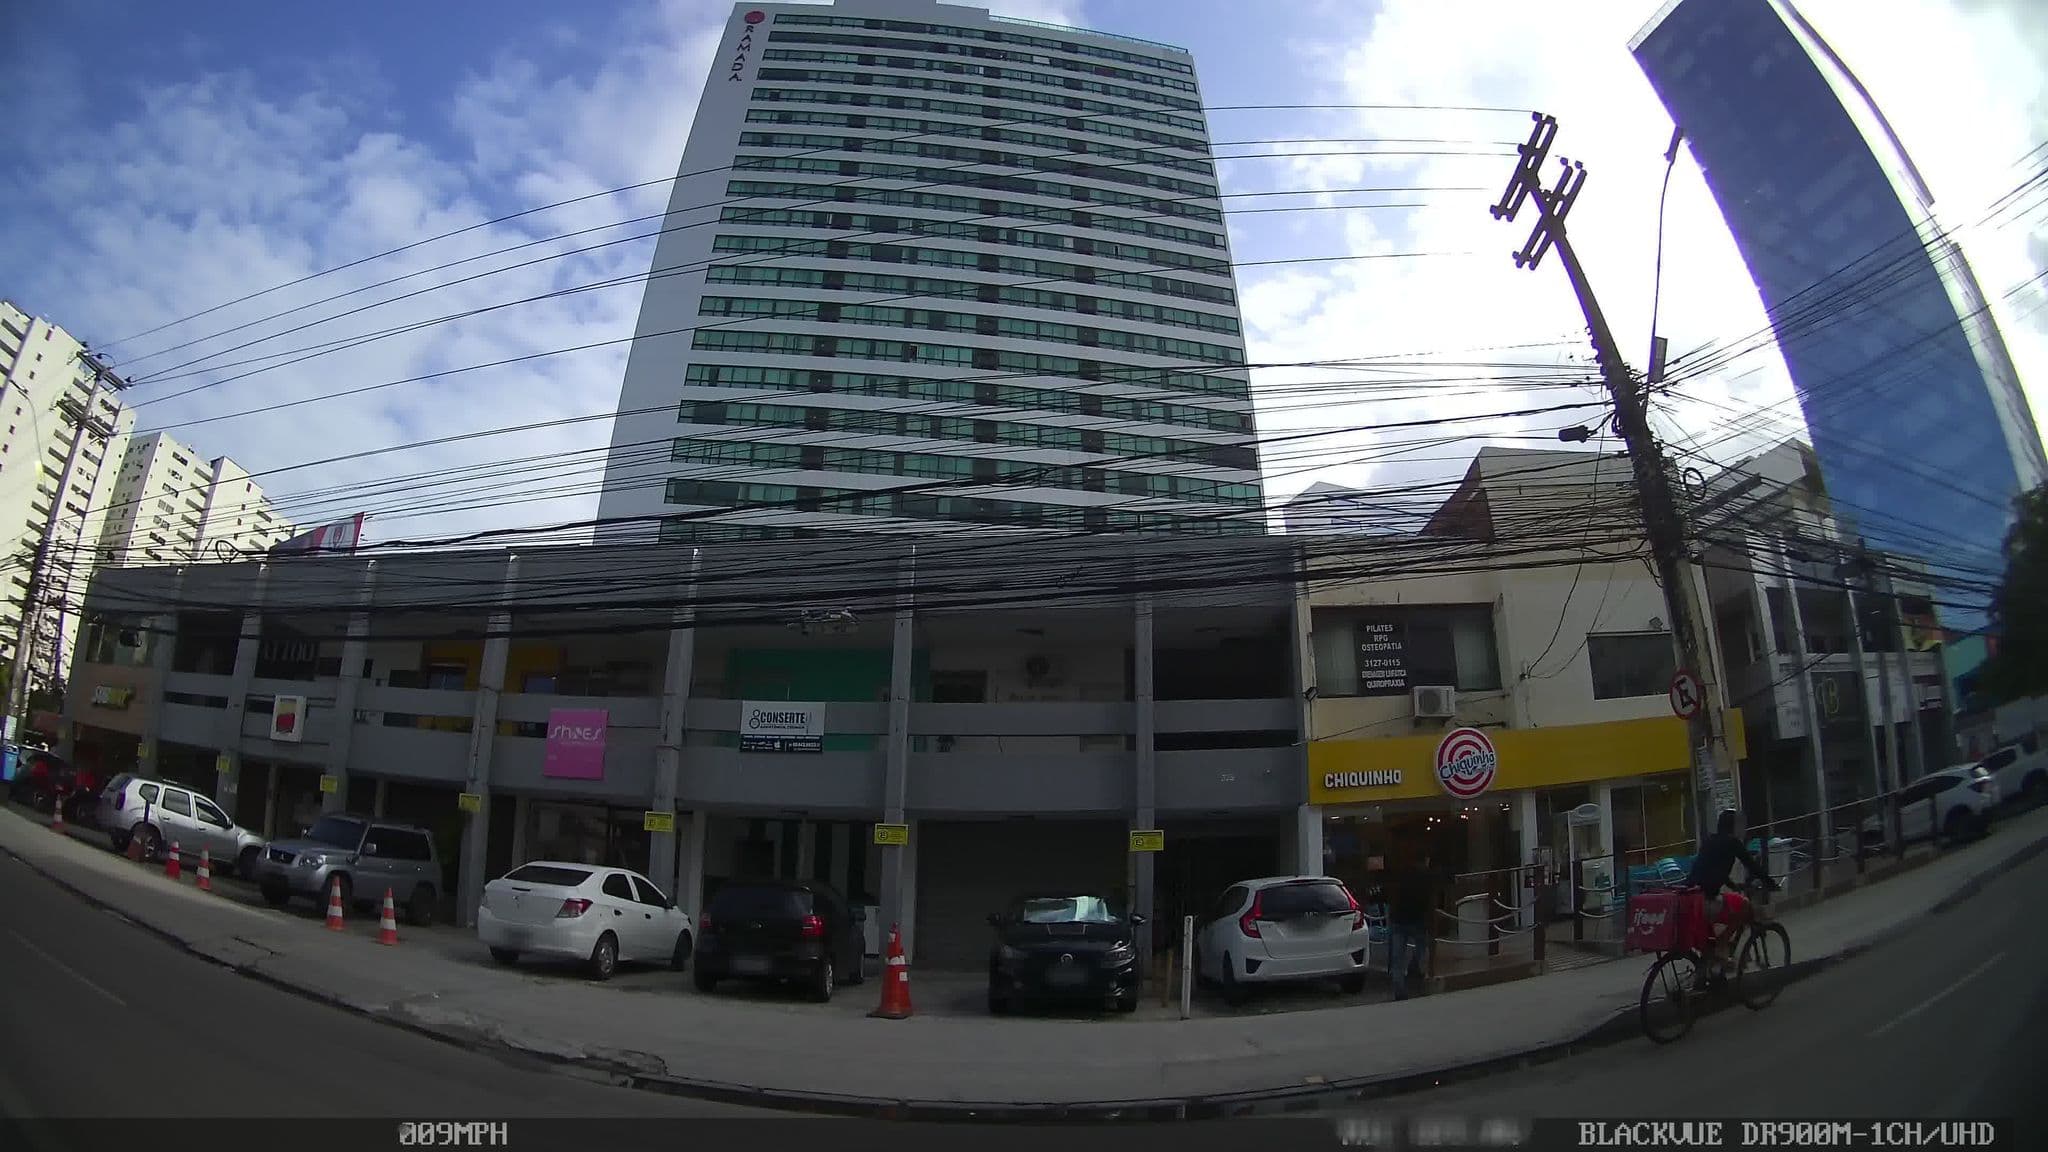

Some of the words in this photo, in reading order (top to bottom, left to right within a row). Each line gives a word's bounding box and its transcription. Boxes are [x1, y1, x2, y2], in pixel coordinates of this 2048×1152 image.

[1366, 624, 1393, 632] PILATES
[1361, 642, 1402, 651] OSTEOPATIA
[1440, 750, 1495, 779] Chiquinho
[1325, 769, 1402, 788] CHIQUINHO
